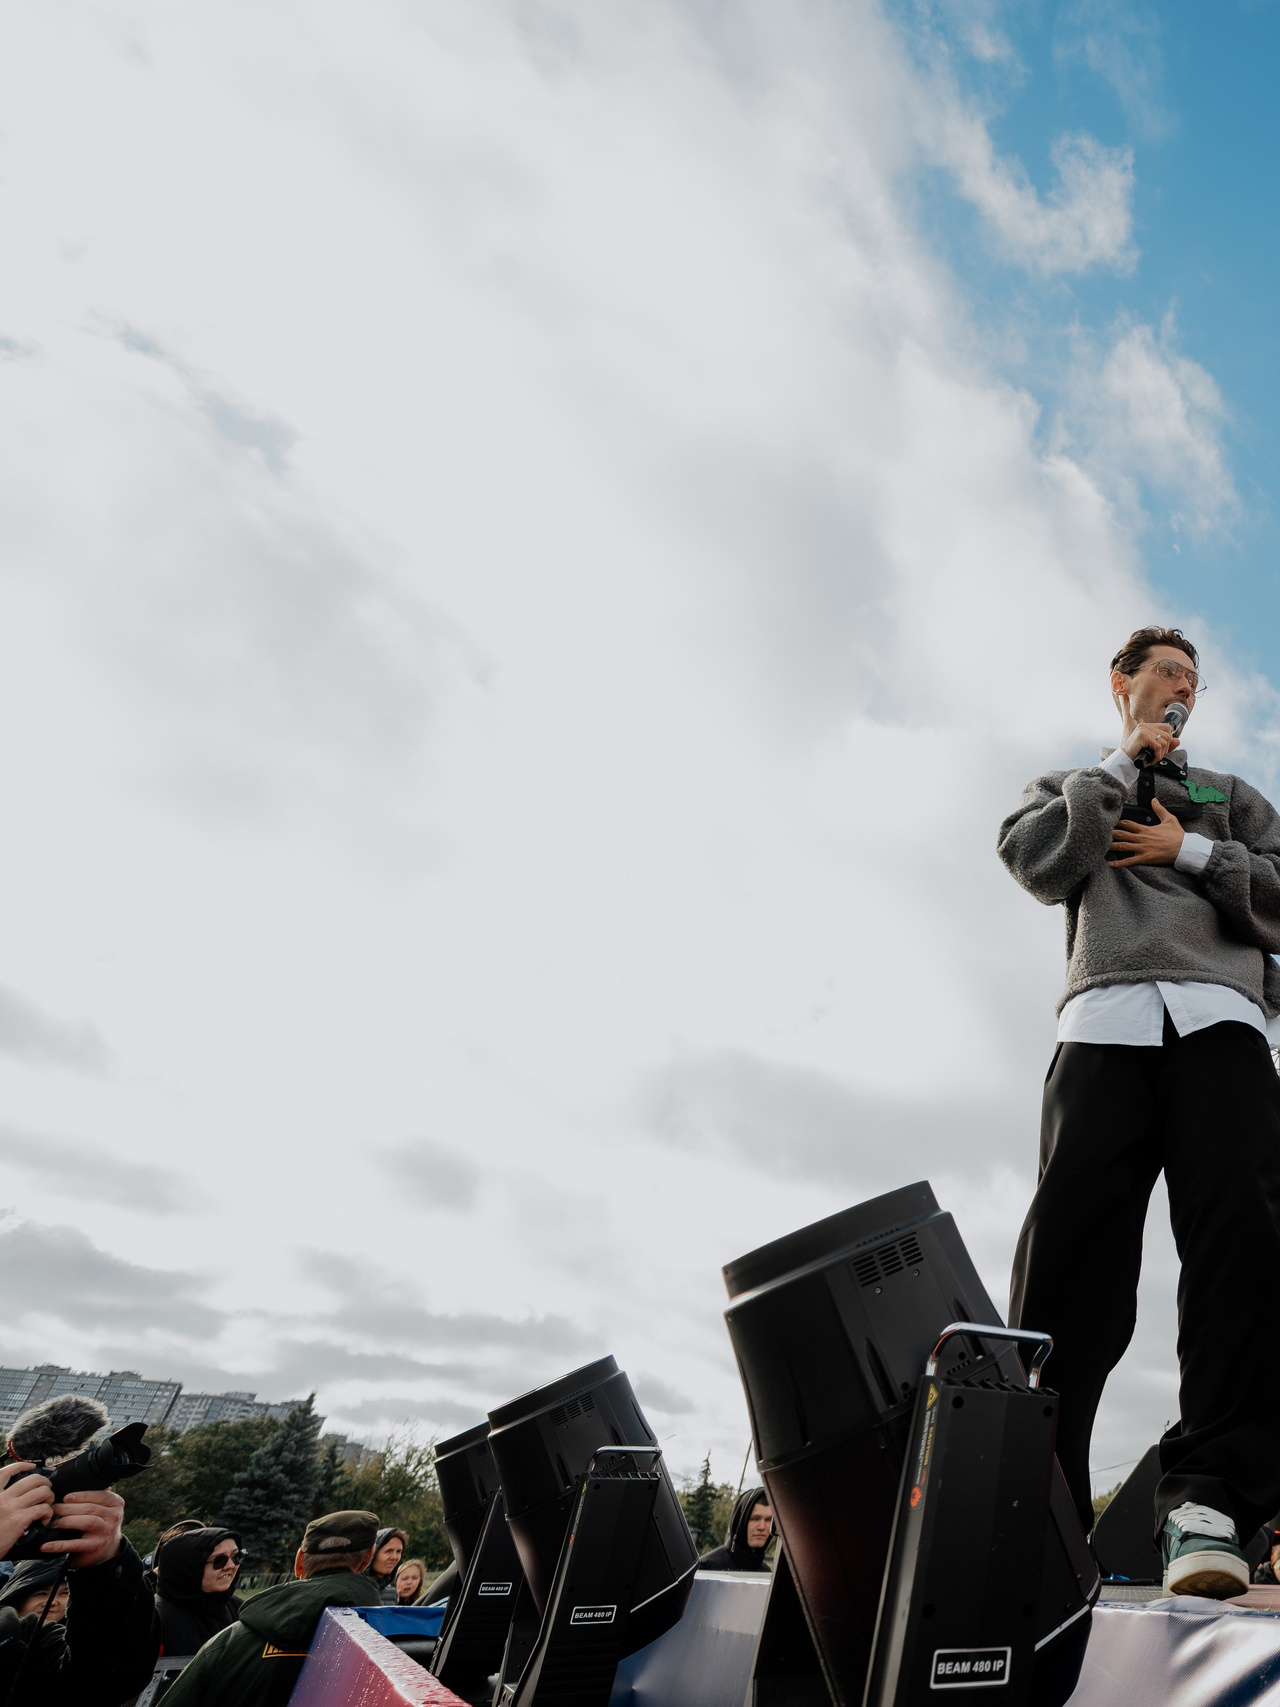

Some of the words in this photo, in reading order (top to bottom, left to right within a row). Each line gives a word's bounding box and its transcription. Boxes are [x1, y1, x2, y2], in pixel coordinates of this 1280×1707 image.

[924, 1426, 934, 1466] CAUTION
[937, 1661, 971, 1675] BEAM
[972, 1660, 991, 1673] 480
[992, 1659, 1004, 1672] IP
